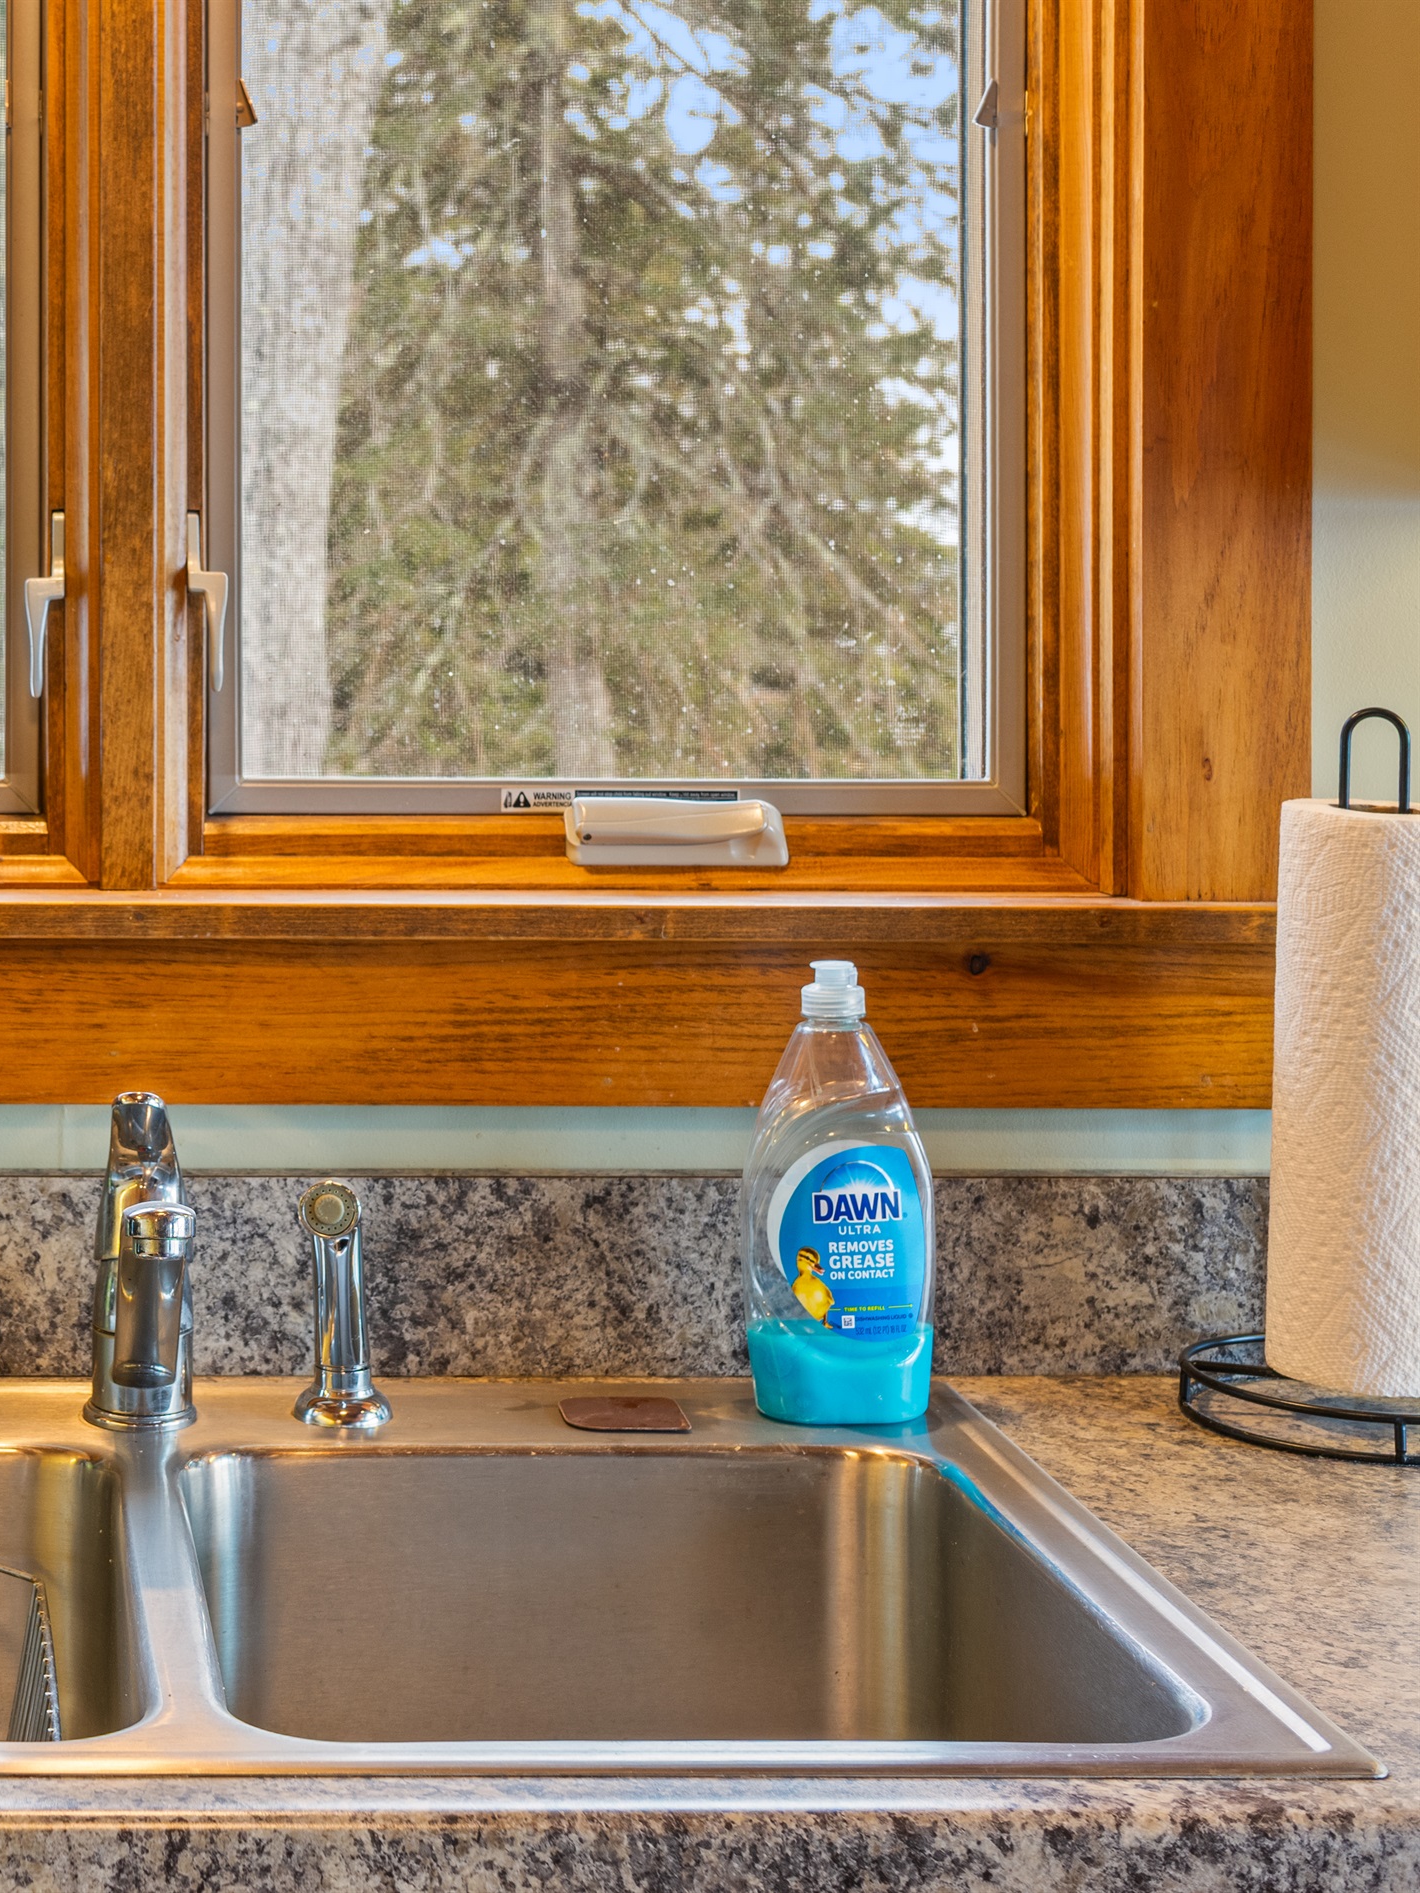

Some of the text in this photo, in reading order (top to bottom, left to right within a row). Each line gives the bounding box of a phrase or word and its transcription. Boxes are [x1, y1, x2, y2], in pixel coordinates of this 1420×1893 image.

[814, 1191, 900, 1222] DAWN
[838, 1224, 881, 1235] ULTRA
[828, 1239, 894, 1253] REMOVES
[829, 1253, 895, 1269] GREASE
[830, 1269, 895, 1280] ON CONTACT
